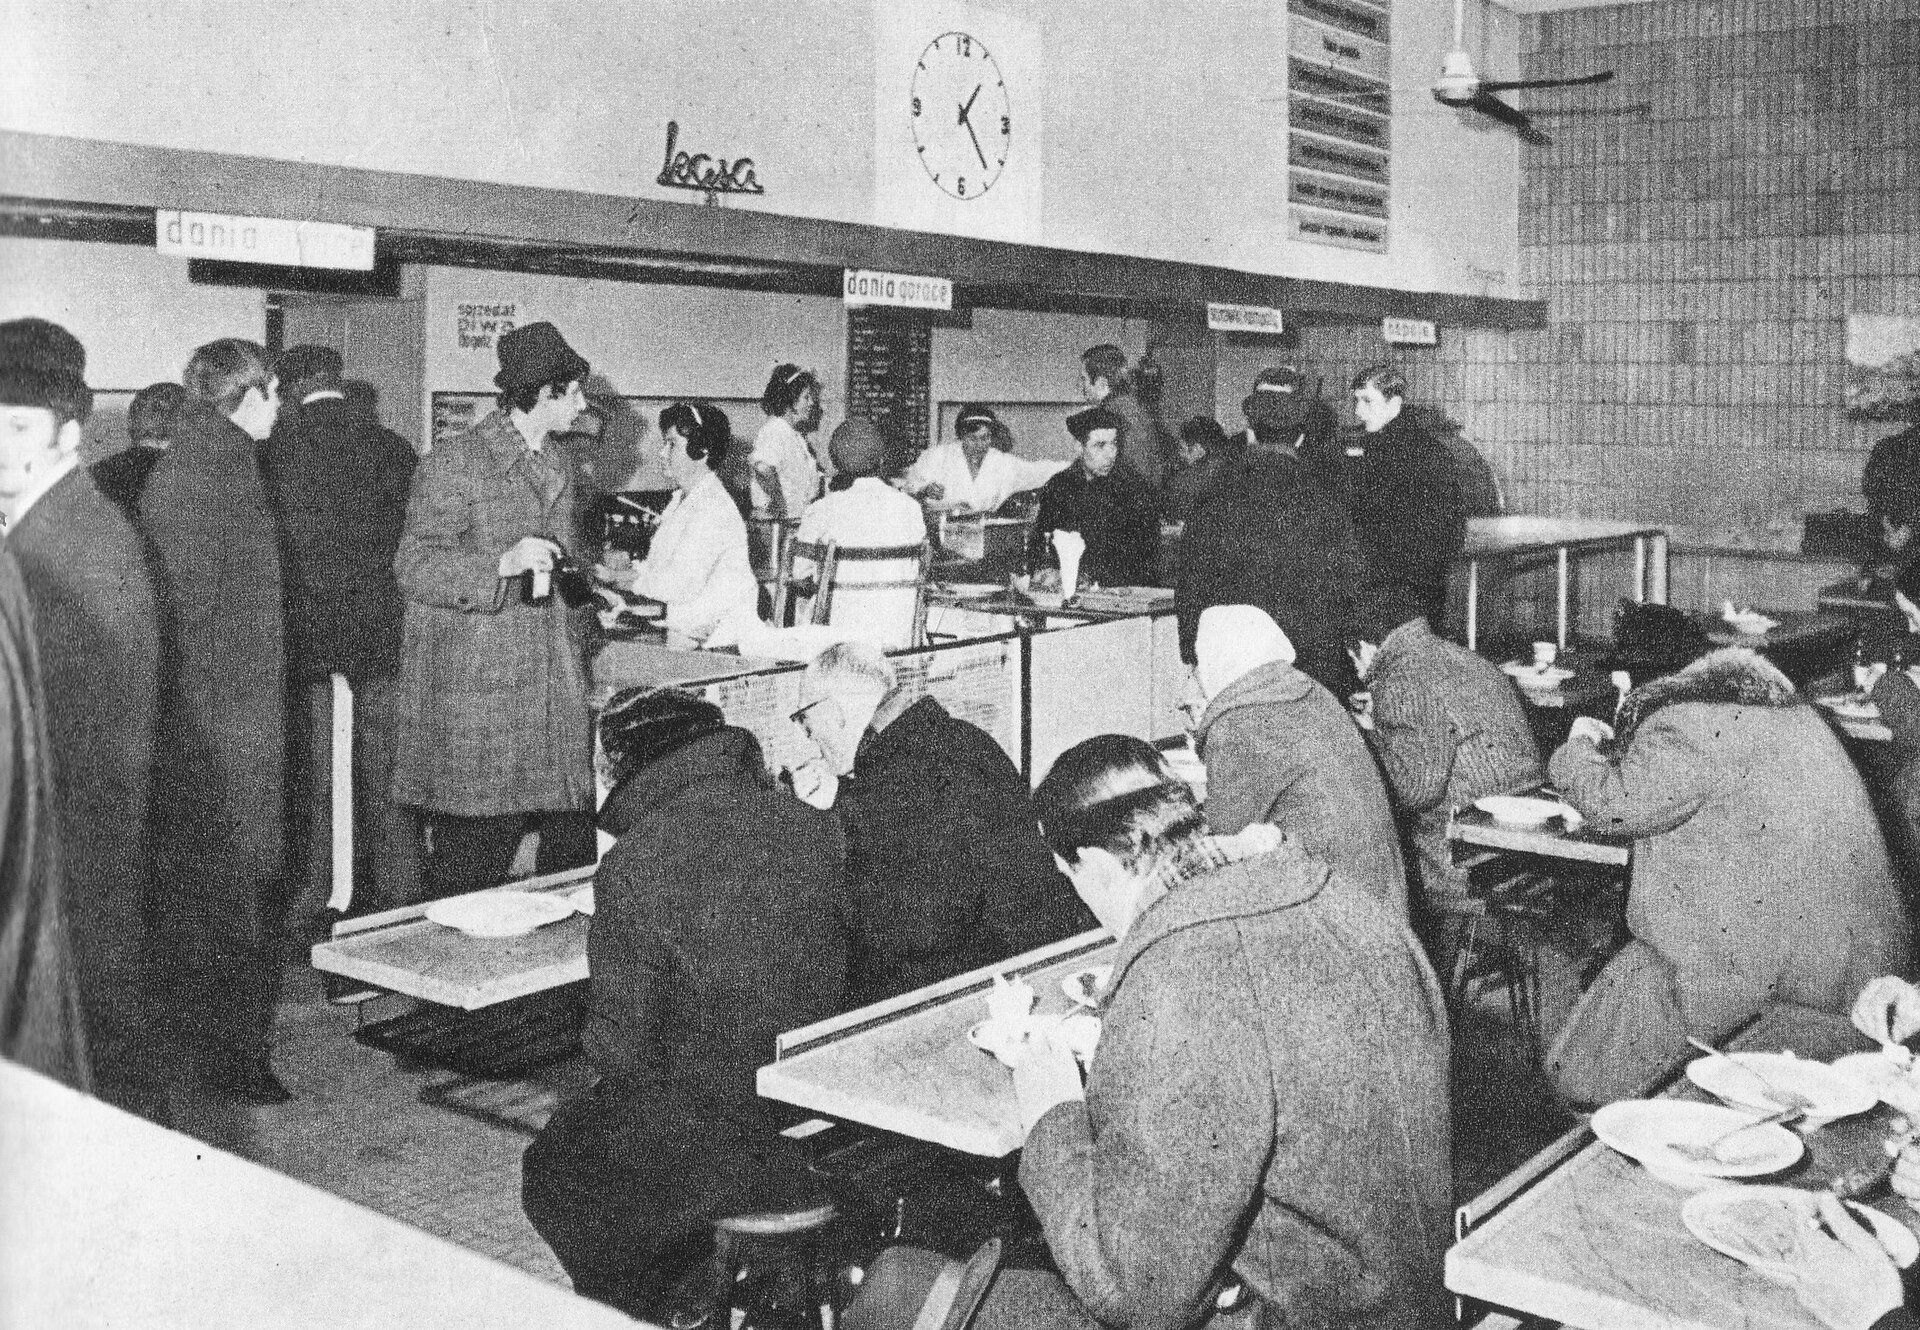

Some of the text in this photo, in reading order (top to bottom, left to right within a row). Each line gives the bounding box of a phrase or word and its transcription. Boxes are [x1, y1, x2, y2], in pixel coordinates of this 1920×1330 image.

[956, 35, 971, 57] 12
[912, 97, 921, 117] 9
[1001, 116, 1010, 135] 3
[957, 177, 966, 196] 6
[166, 210, 257, 249] dania
[847, 271, 895, 298] dania
